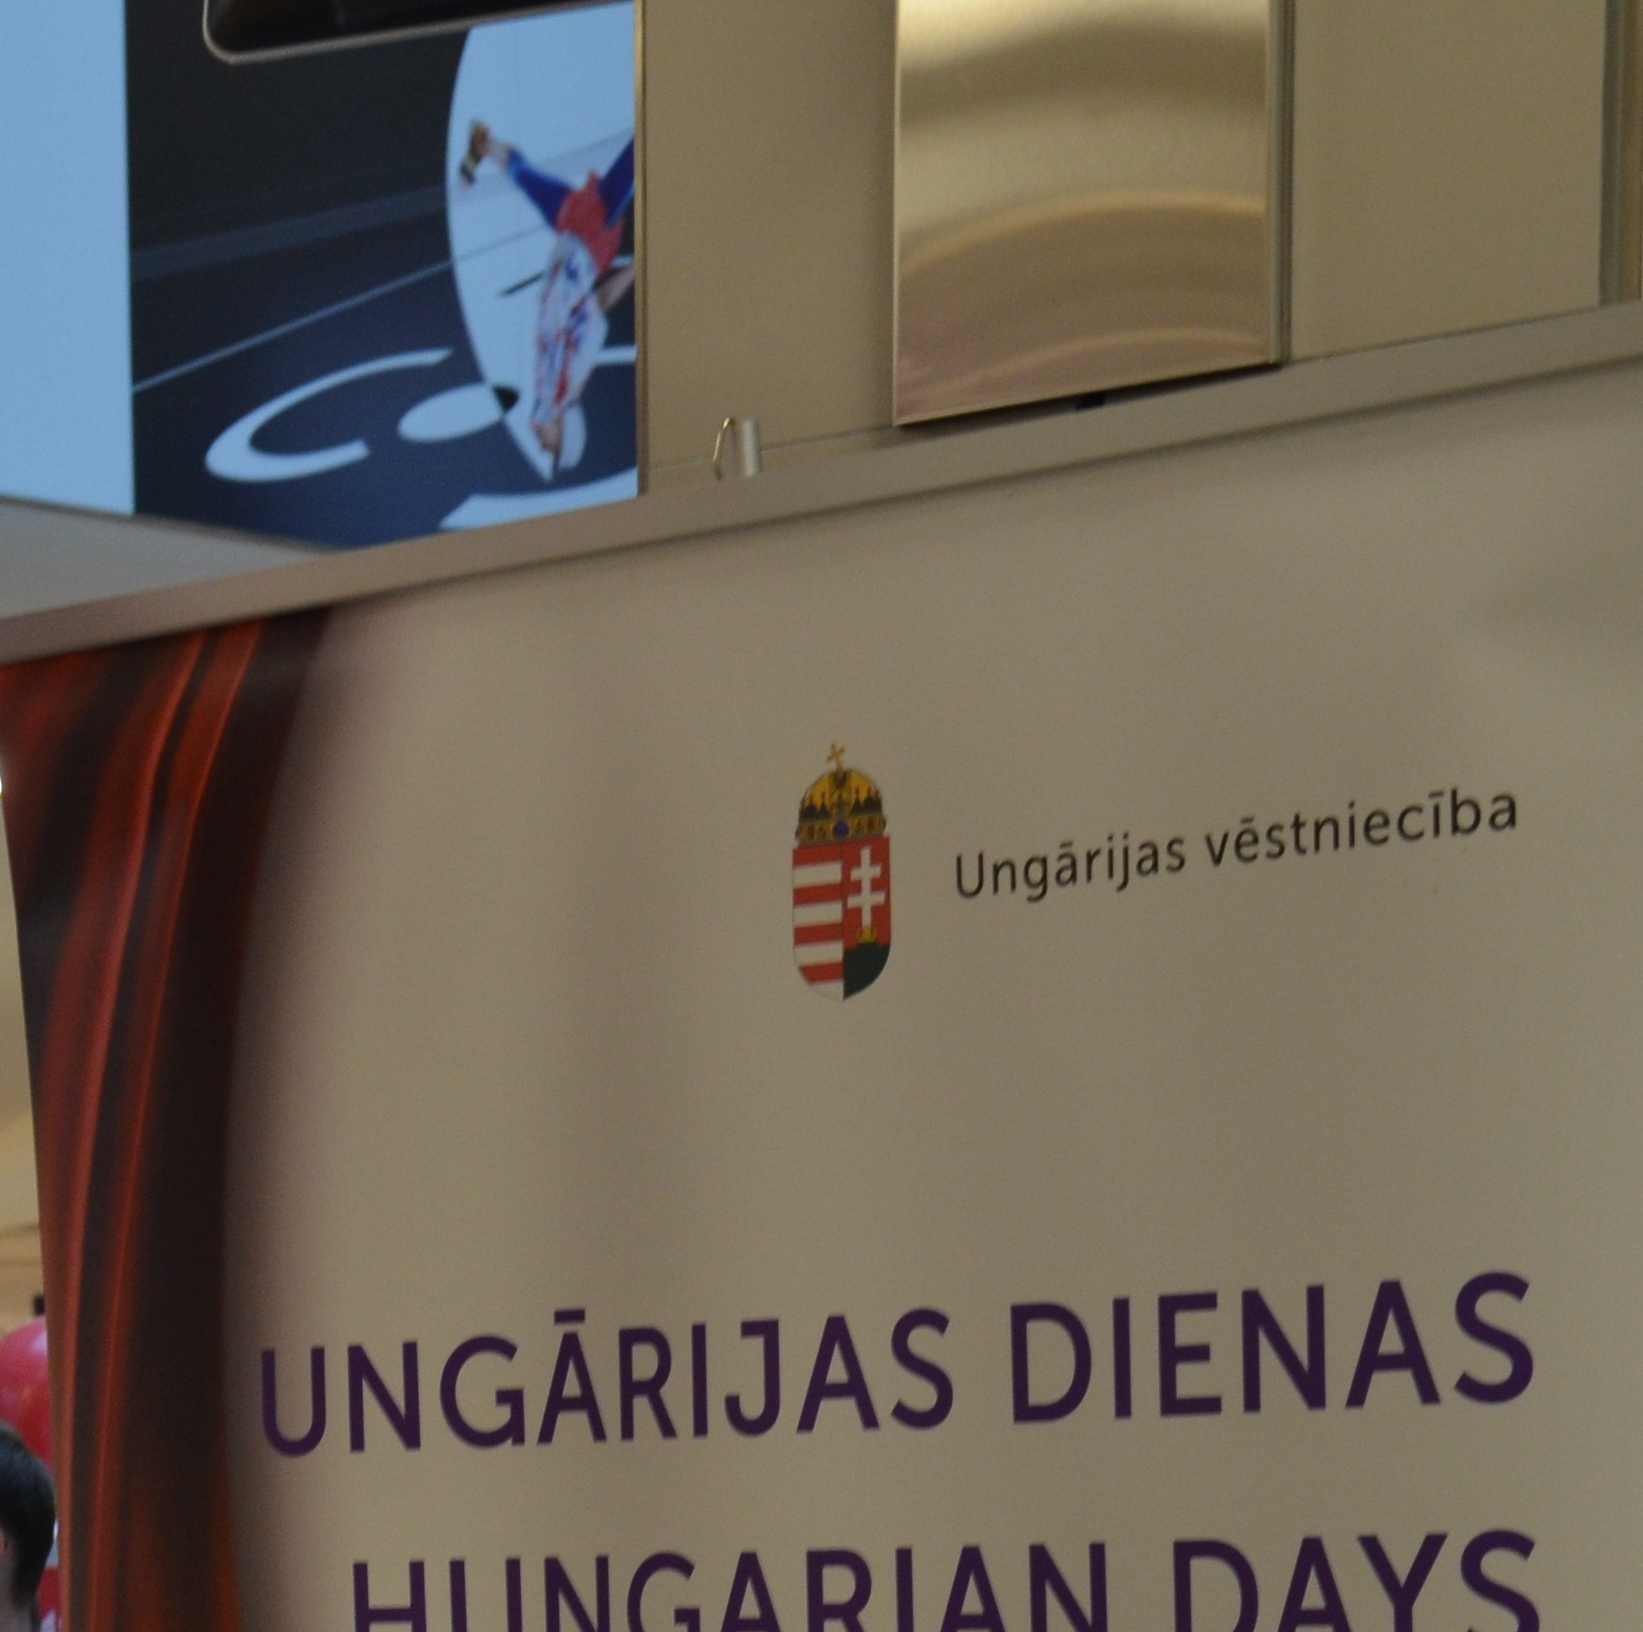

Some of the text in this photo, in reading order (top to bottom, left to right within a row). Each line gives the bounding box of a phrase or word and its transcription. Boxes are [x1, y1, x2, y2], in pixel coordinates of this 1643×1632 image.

[954, 787, 1521, 903] Ungārijas vēstniecība
[259, 1271, 1537, 1459] UNGĀRIJAS DIENAS
